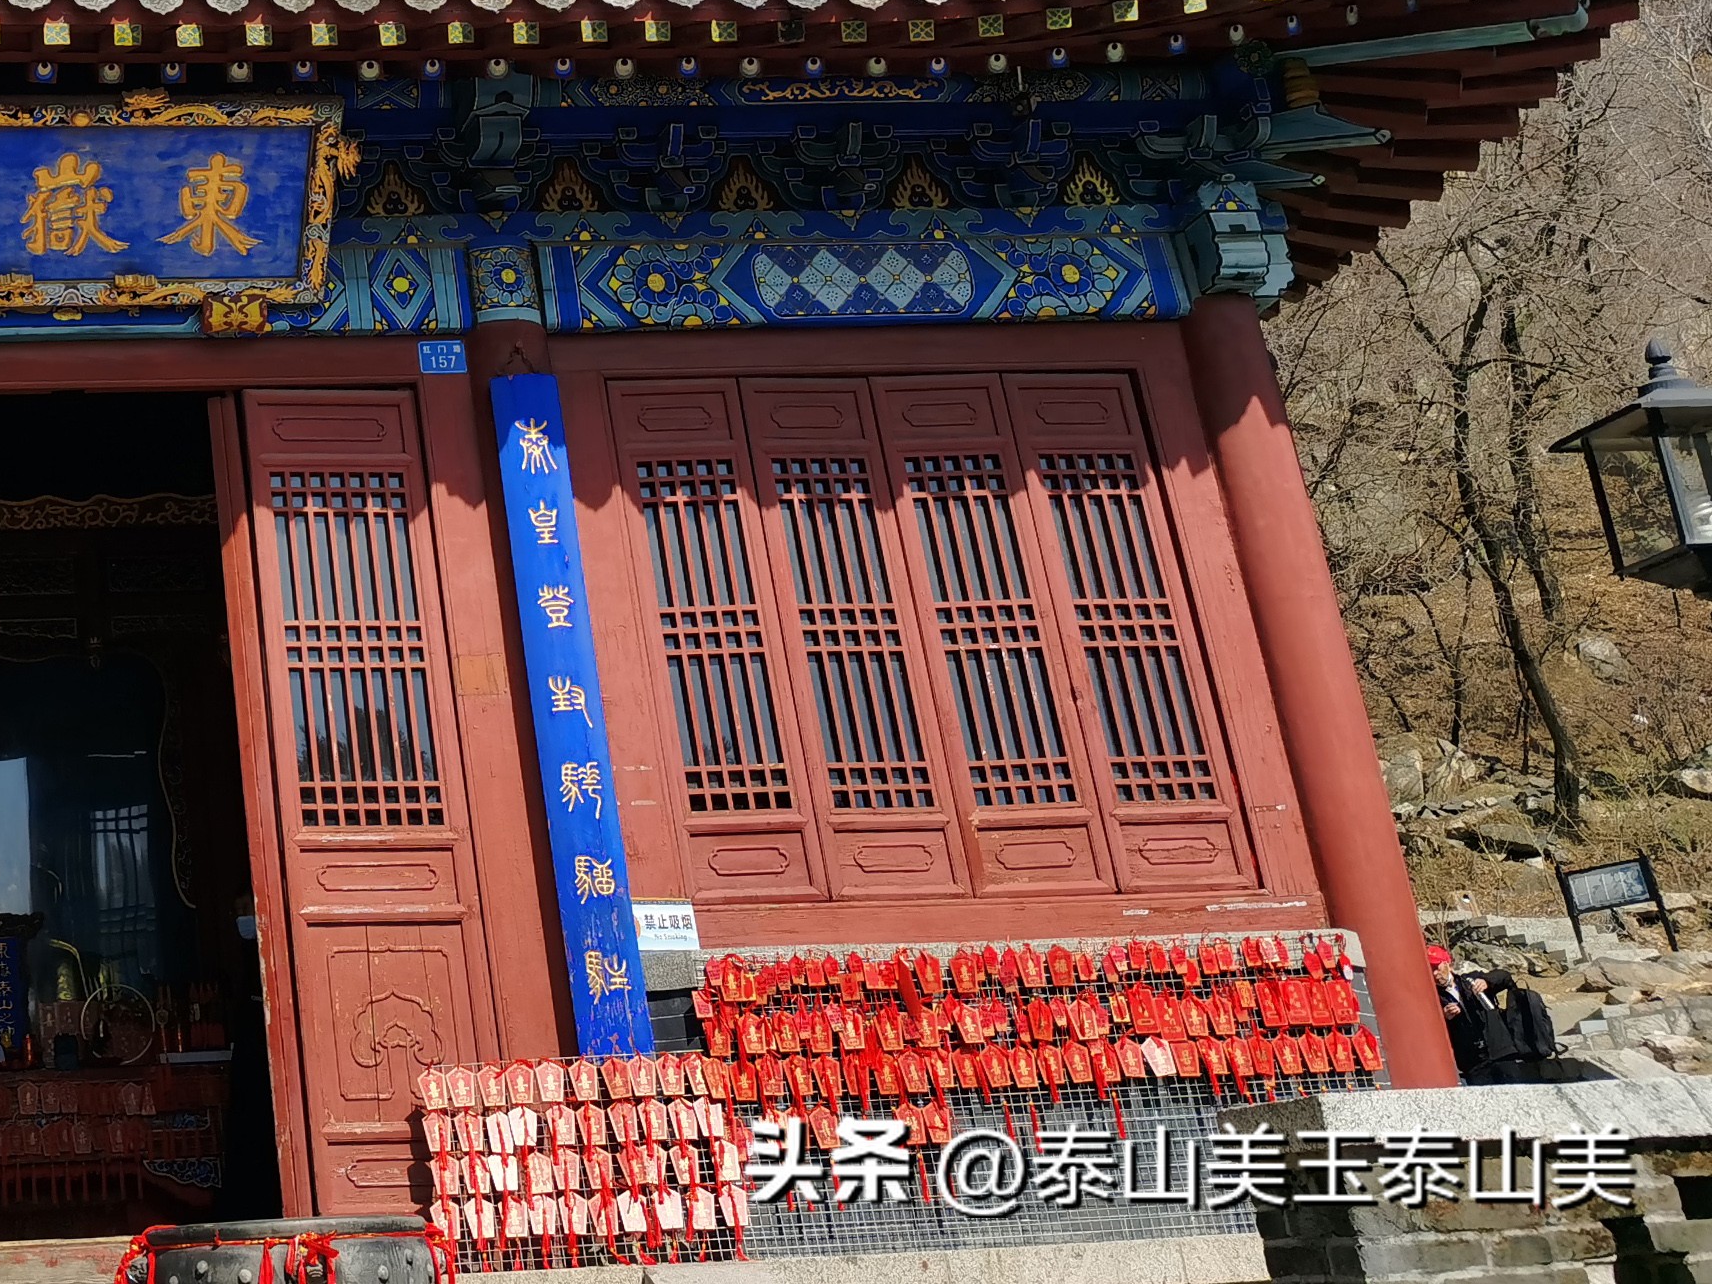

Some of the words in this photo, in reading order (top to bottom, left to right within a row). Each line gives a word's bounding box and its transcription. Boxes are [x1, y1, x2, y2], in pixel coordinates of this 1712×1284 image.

[430, 355, 456, 369] 157
[644, 914, 693, 930] 禁止吸烟
